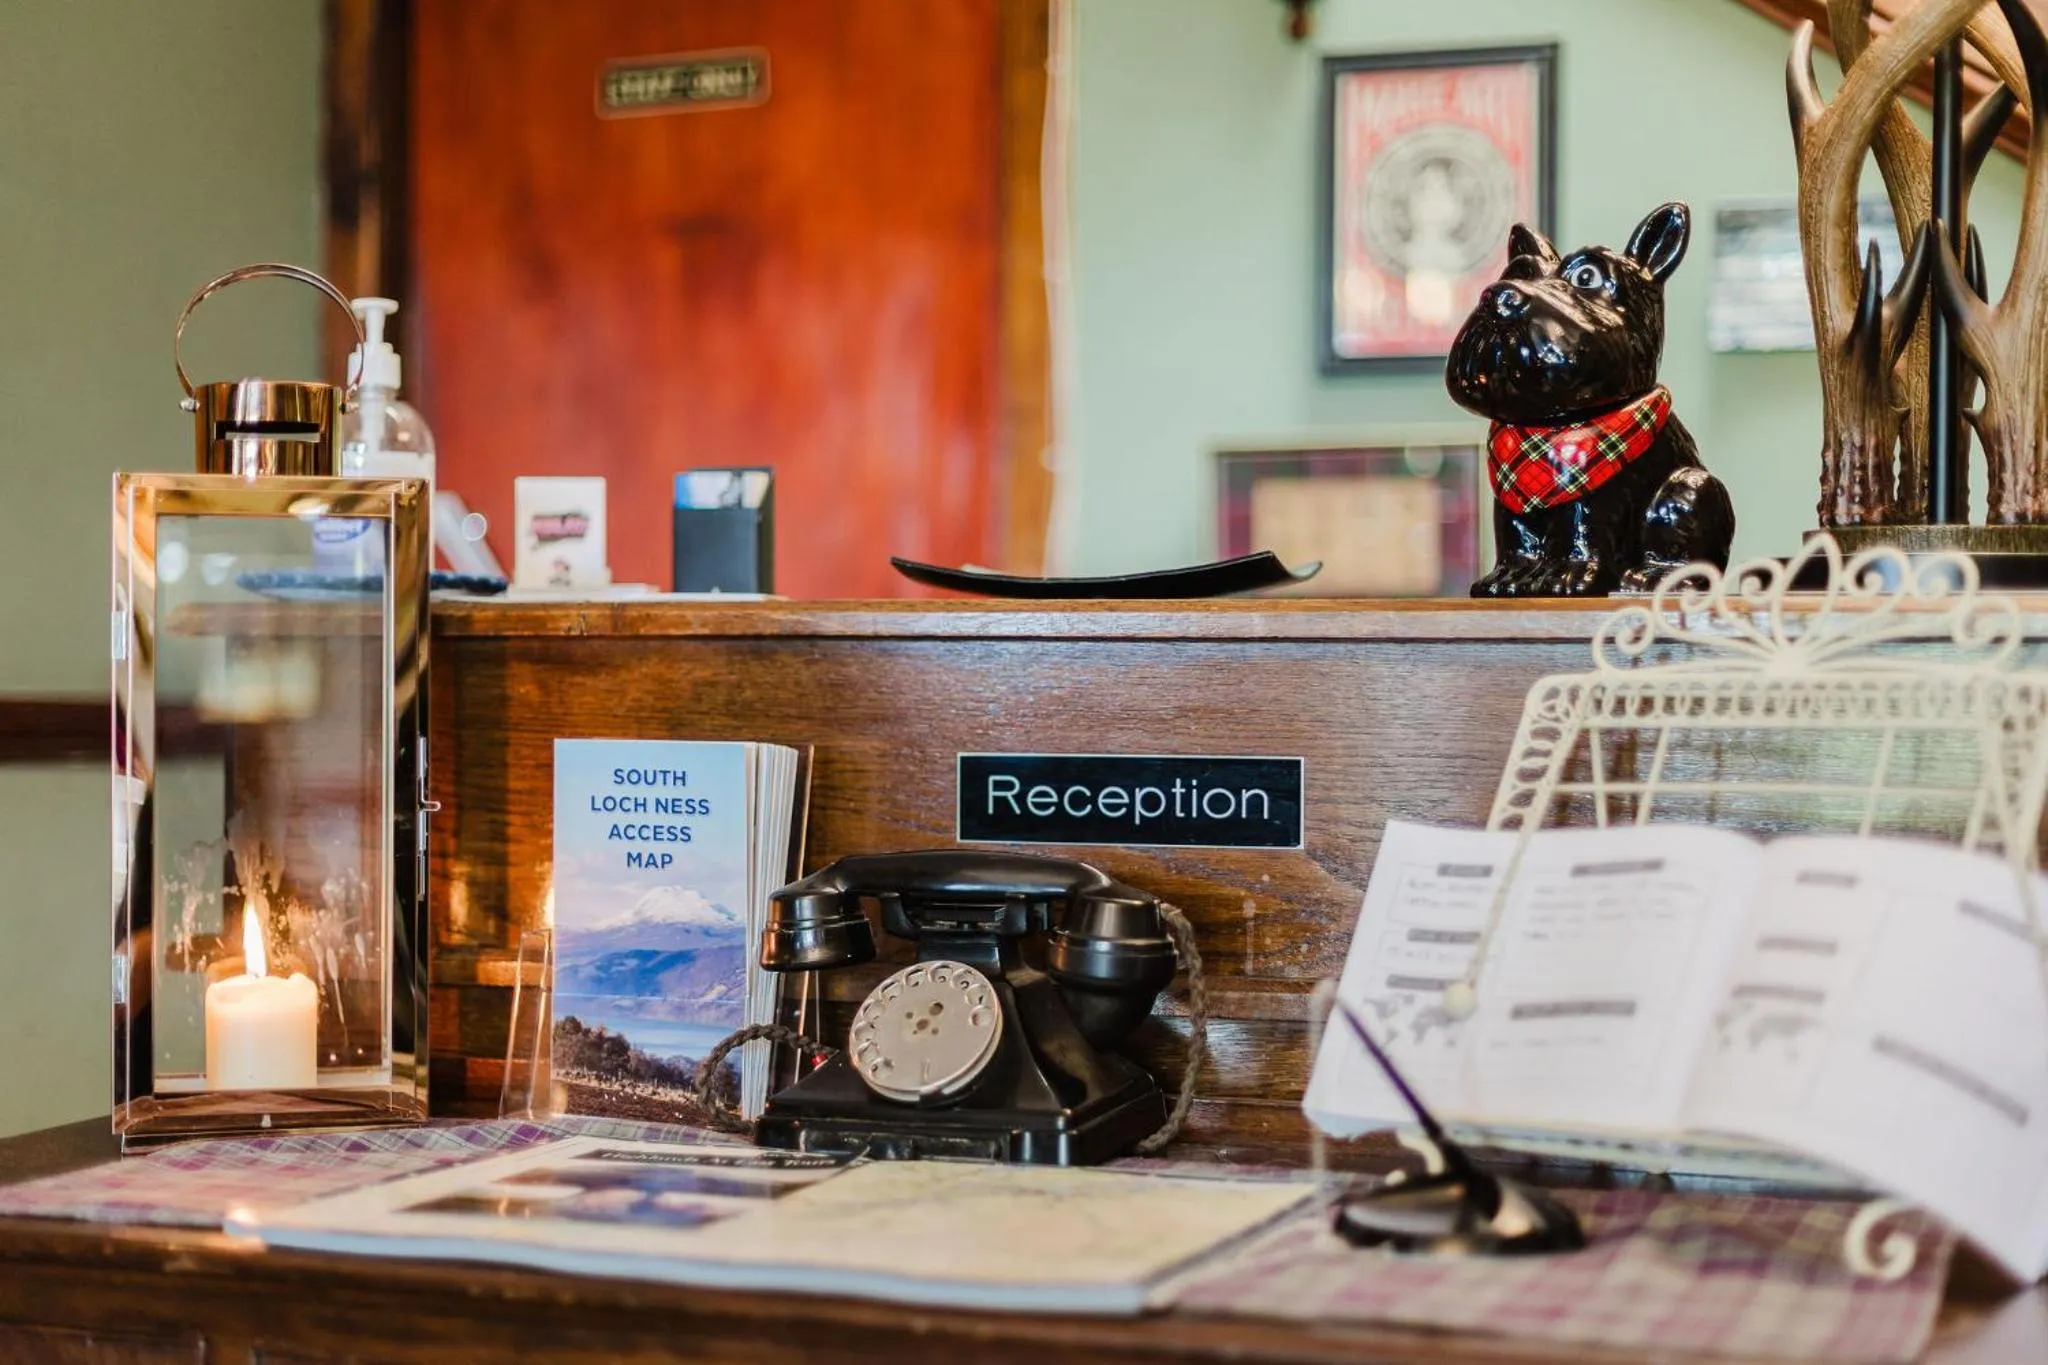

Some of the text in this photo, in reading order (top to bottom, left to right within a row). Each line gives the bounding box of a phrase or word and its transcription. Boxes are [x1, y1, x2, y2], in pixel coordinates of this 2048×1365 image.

[613, 768, 687, 787] SOUTH
[590, 795, 711, 816] LOCH NESS
[988, 775, 1269, 825] Reception
[608, 823, 692, 843] ACCESS
[626, 851, 674, 869] MAP
